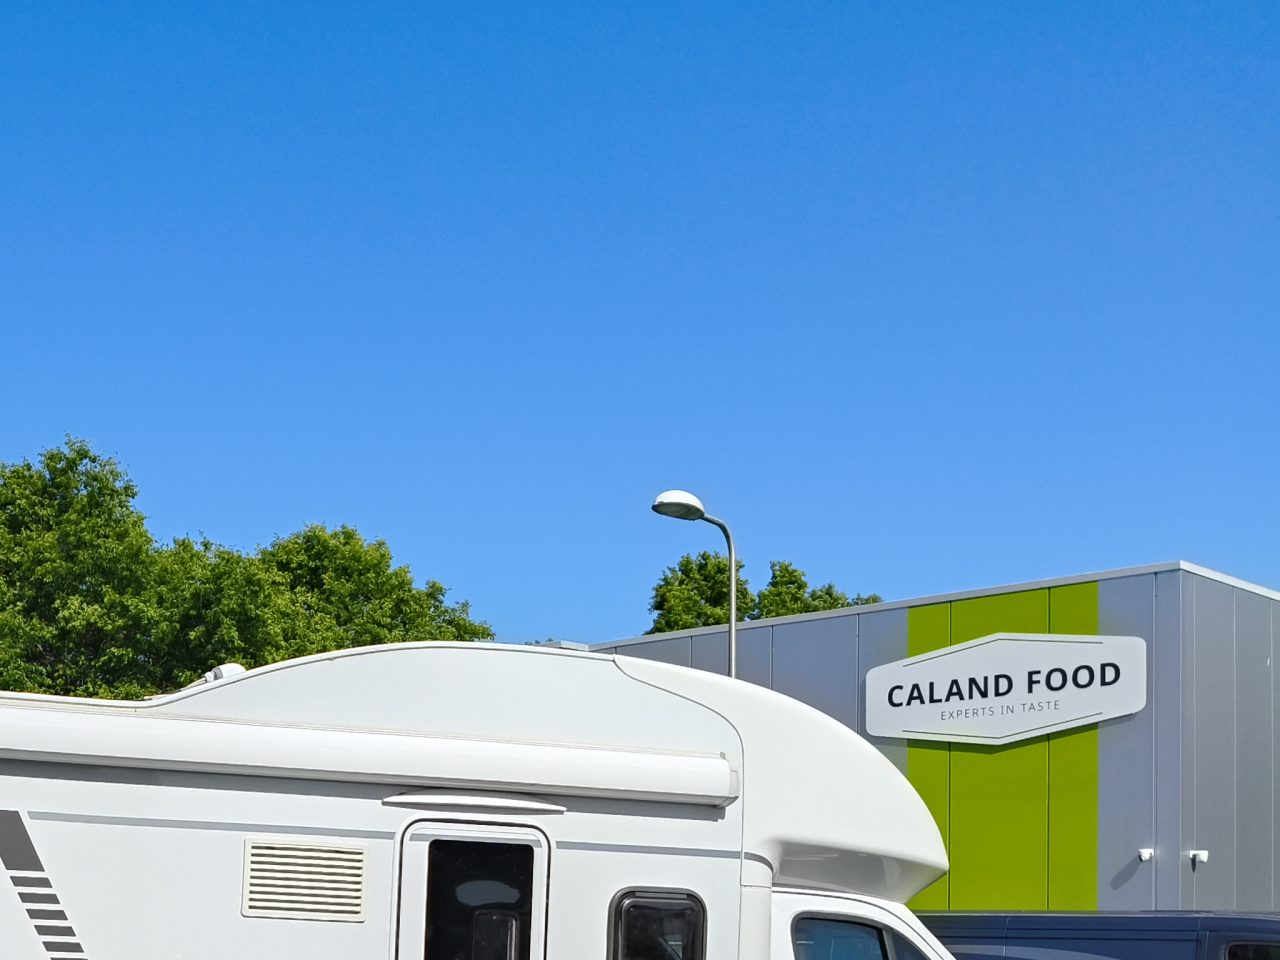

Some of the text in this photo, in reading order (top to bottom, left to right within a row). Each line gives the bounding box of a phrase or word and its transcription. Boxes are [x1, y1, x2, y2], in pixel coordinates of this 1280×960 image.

[887, 661, 1122, 707] CALAND FOOD
[939, 699, 1061, 721] EXPERTS IN TASTE
